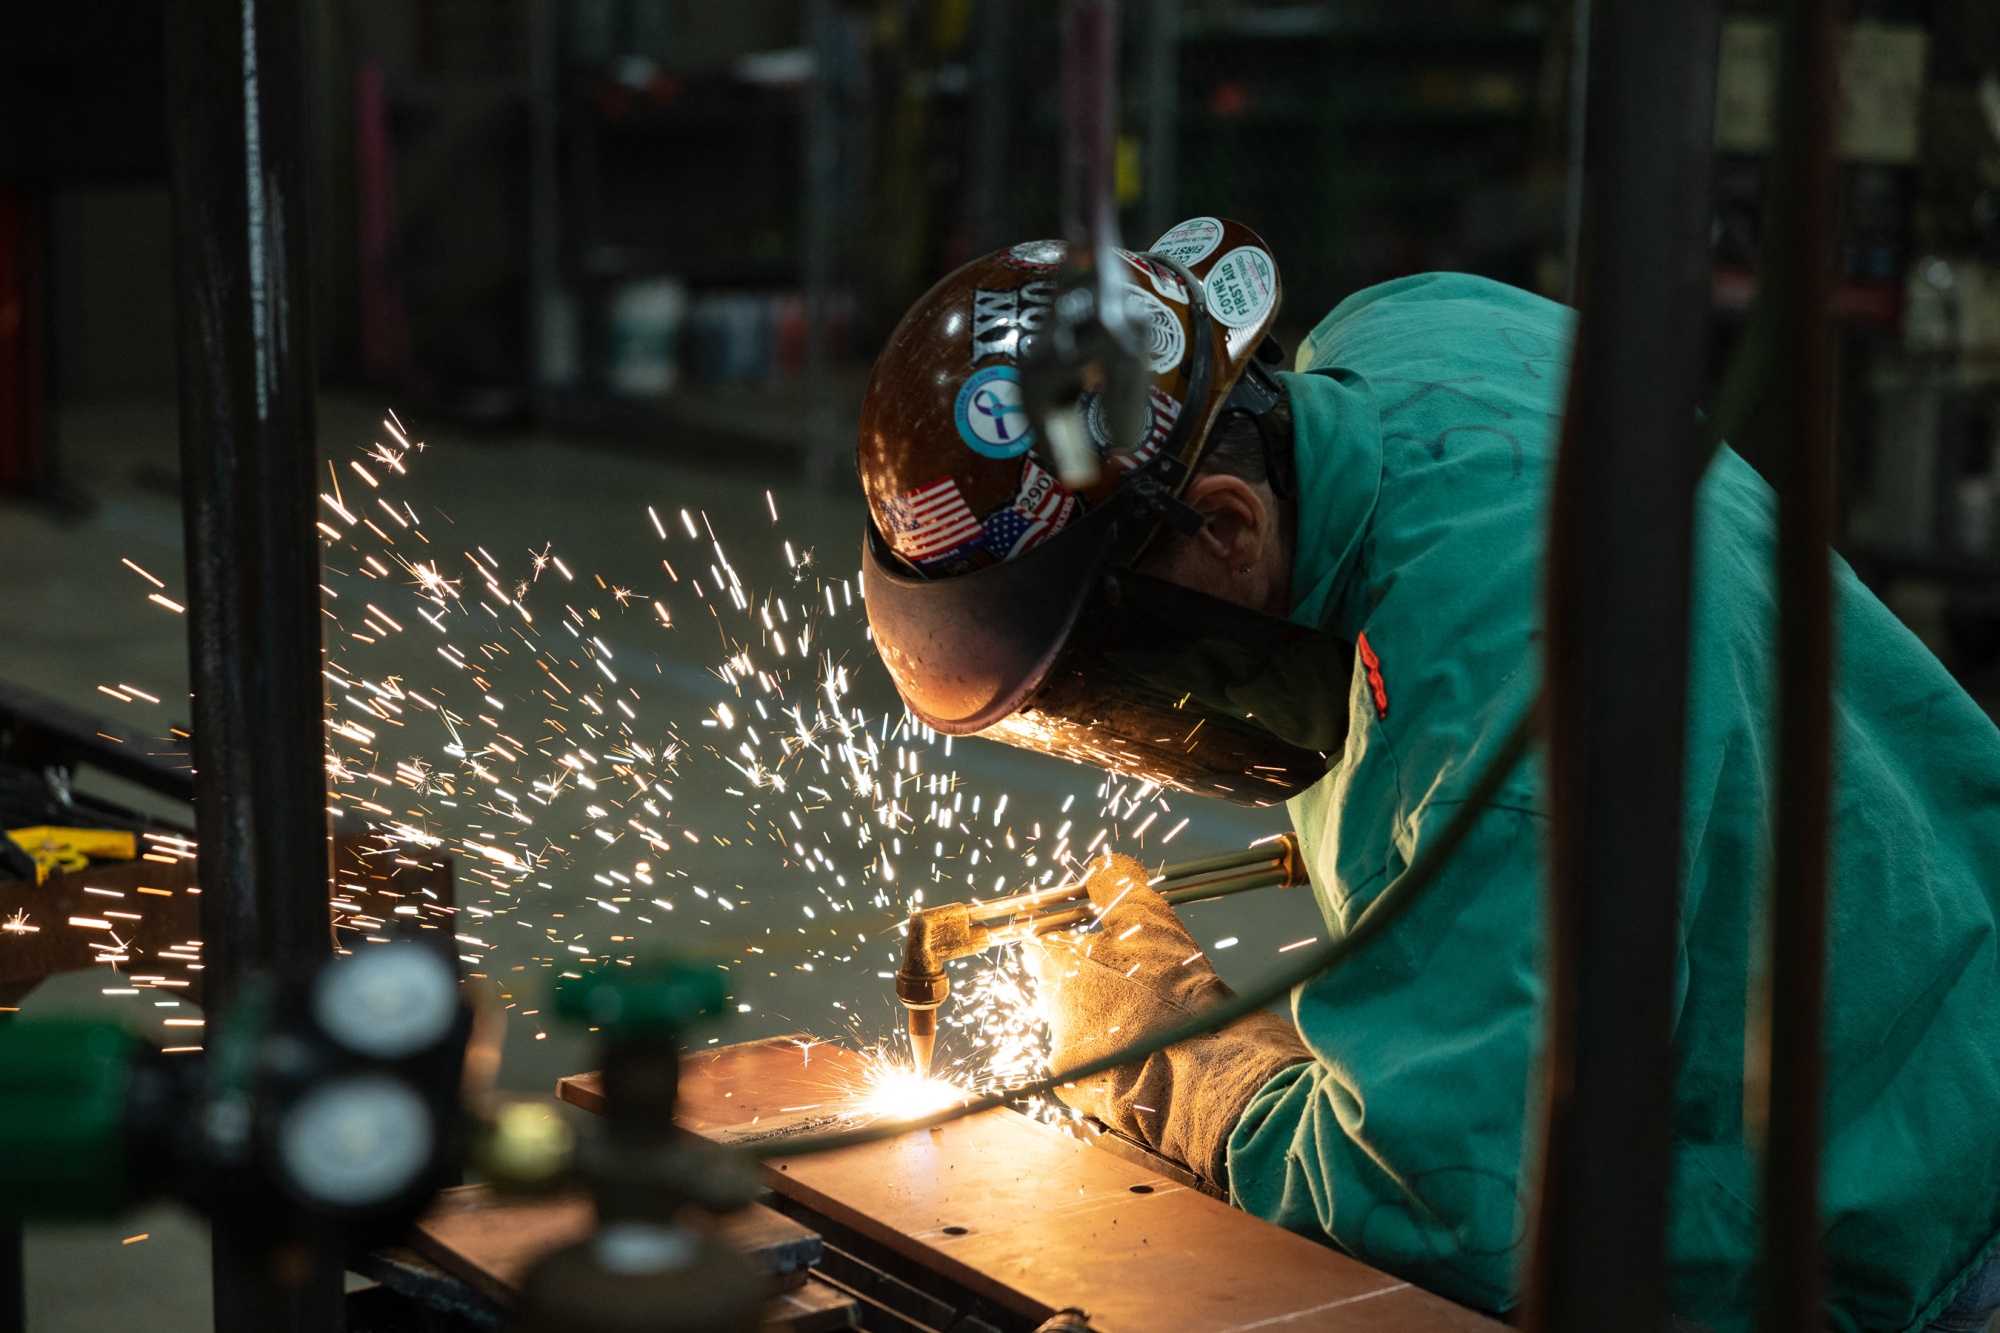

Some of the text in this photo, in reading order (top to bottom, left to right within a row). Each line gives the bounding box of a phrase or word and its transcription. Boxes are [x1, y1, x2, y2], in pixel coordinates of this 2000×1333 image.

[1171, 245, 1205, 256] FIRST
[1212, 277, 1234, 315] COYNE
[1221, 263, 1250, 316] FIRST AID
[1020, 477, 1051, 511] 290
